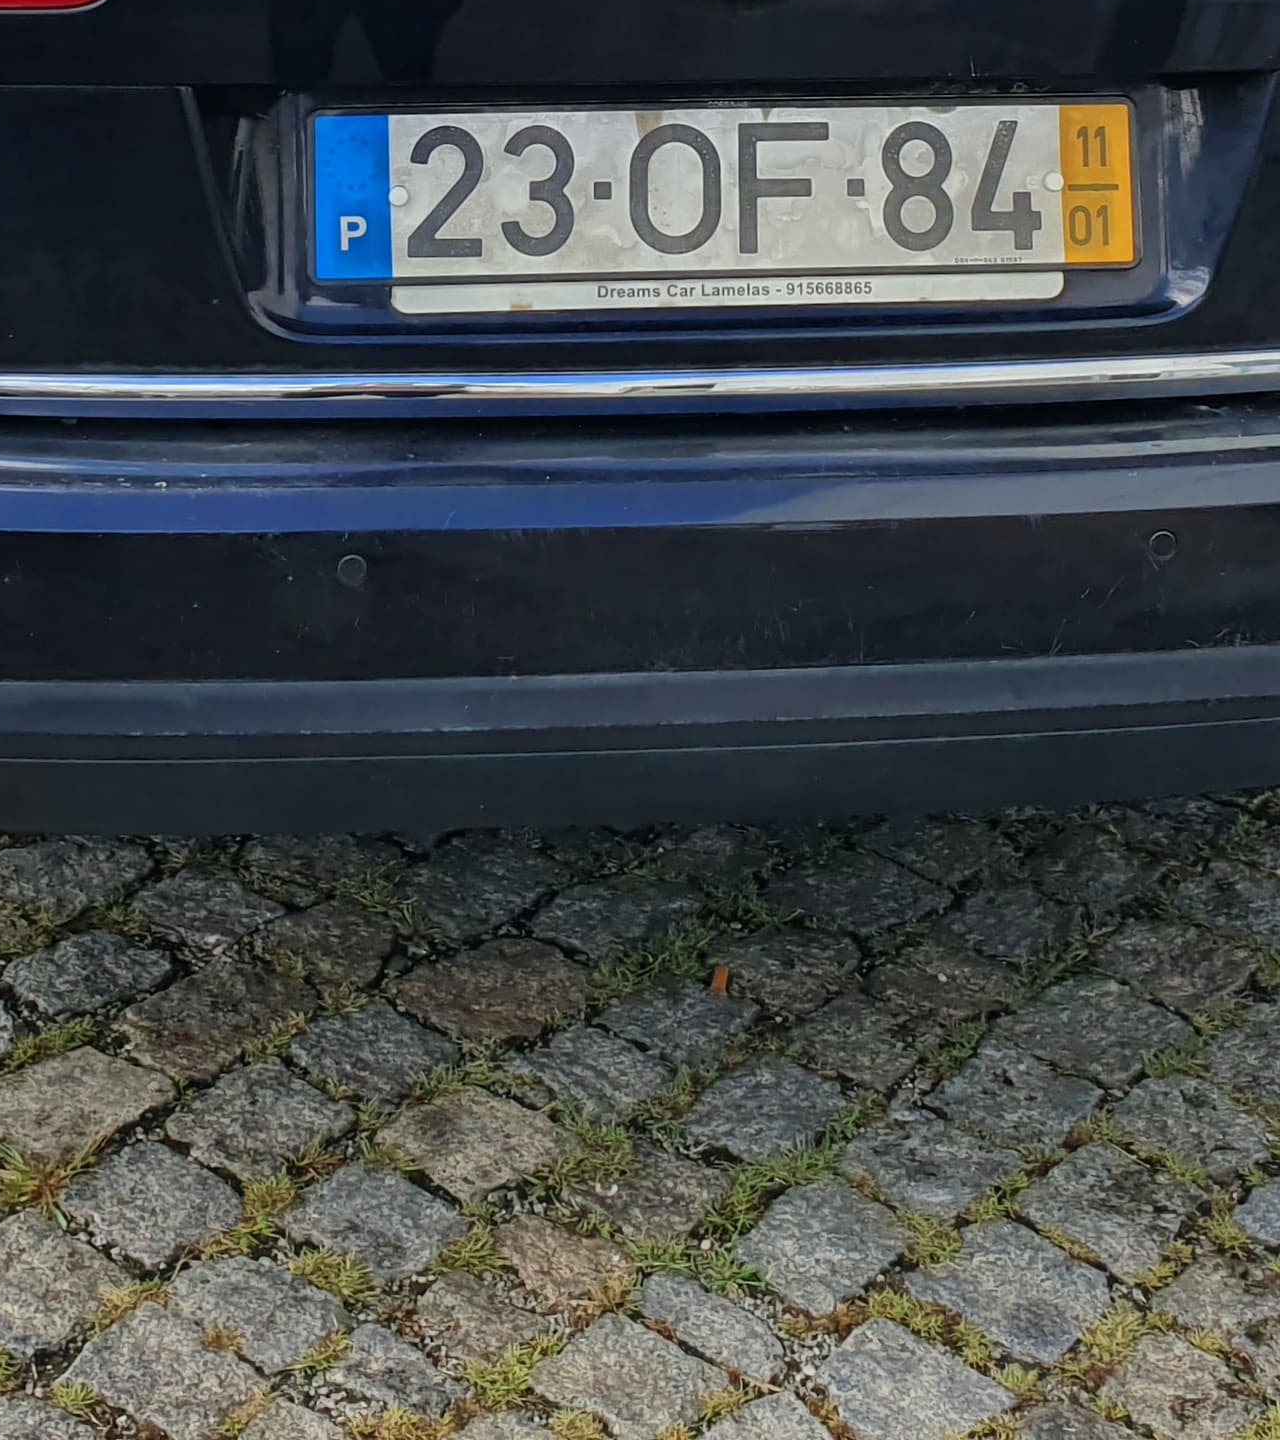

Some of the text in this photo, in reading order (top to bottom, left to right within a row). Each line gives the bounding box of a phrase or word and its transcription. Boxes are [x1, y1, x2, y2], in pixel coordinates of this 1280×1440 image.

[1076, 125, 1108, 168] 11
[339, 215, 368, 252] P
[1069, 203, 1110, 247] 01
[597, 284, 661, 299] Dreams
[666, 283, 696, 298] Car
[700, 282, 771, 297] Lamelas
[785, 281, 873, 296] 915668865
